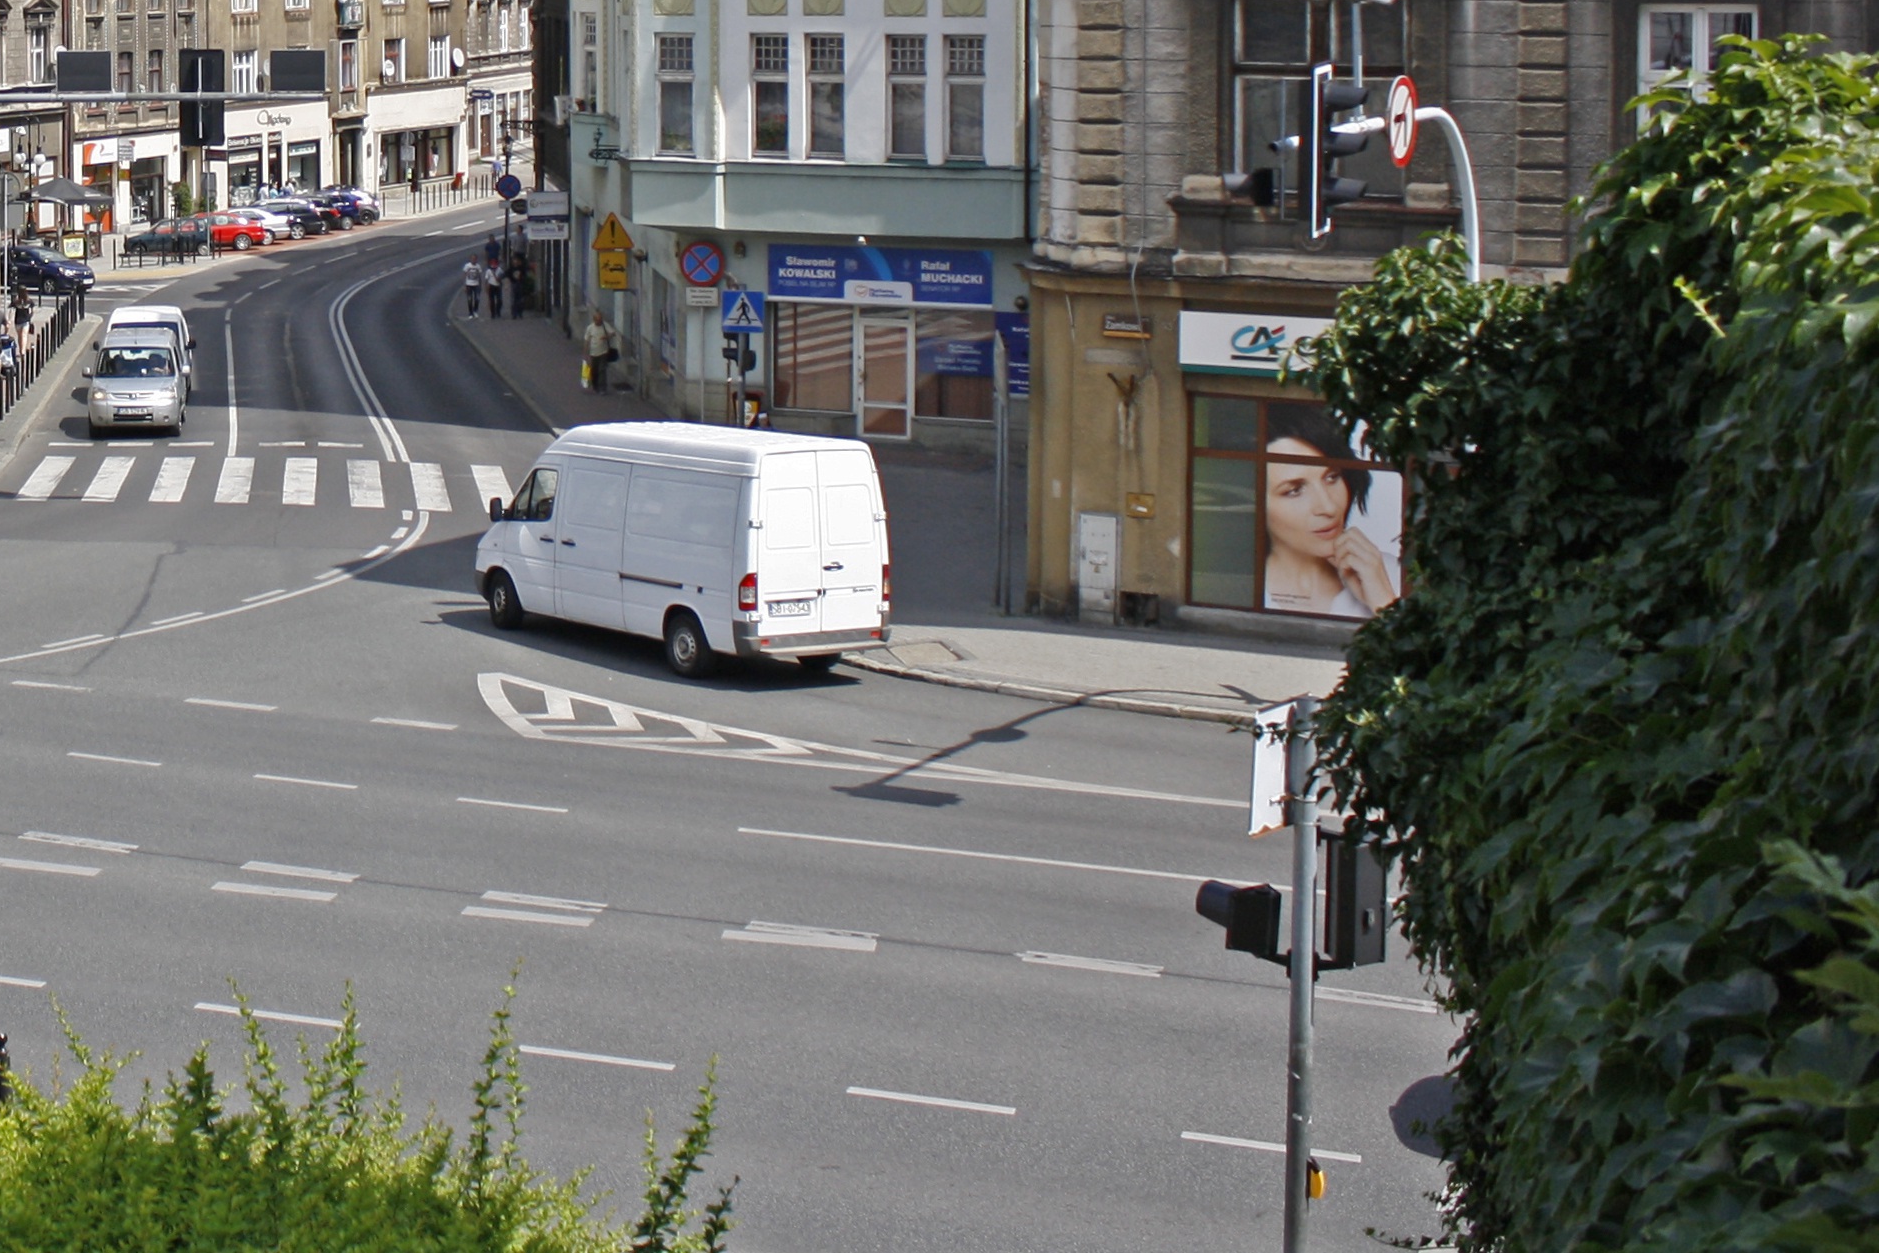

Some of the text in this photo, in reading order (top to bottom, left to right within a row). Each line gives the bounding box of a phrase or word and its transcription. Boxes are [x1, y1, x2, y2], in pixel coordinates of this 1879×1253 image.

[785, 256, 836, 267] Sławomir
[778, 268, 836, 279] KOWALSKI
[921, 273, 984, 284] MUCHACKI
